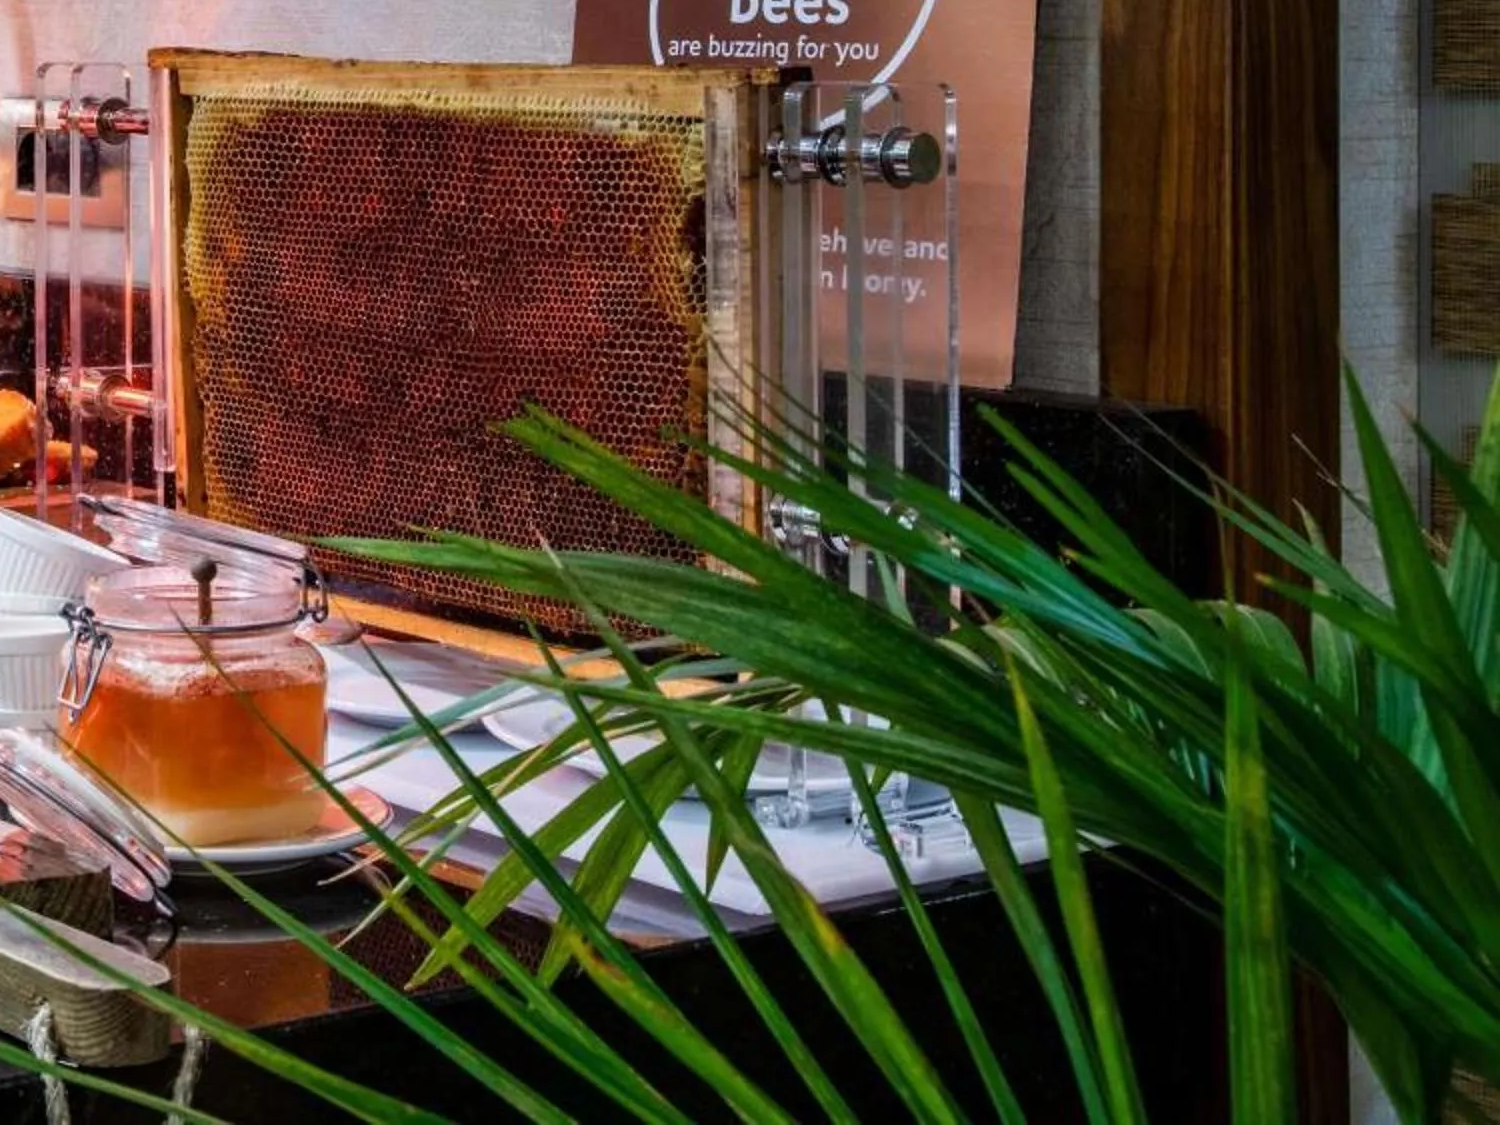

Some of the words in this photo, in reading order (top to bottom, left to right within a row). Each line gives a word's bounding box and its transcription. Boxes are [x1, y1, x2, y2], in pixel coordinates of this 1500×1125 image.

[668, 38, 701, 56] are
[708, 34, 789, 63] buzzing
[797, 36, 830, 59] for
[834, 41, 879, 66] you
